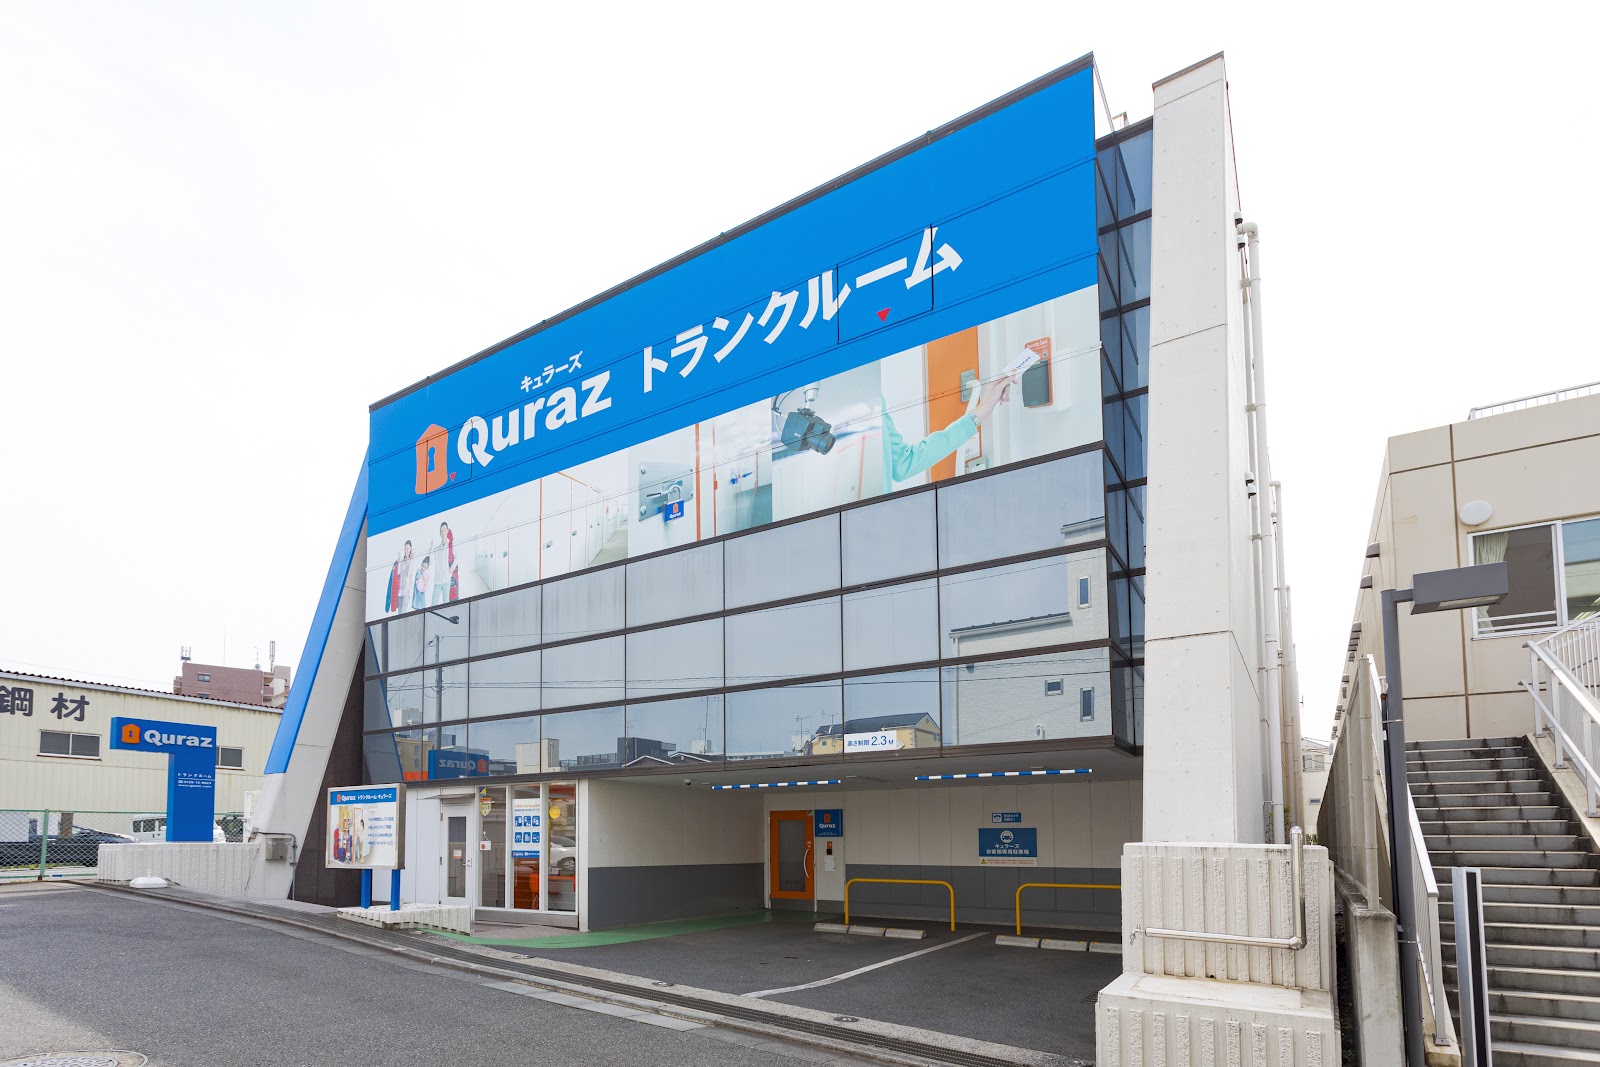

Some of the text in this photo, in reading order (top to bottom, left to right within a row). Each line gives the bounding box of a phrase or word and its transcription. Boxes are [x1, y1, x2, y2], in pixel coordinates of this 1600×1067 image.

[643, 226, 963, 393] トランクルーム
[520, 350, 583, 393] キュラーズ
[457, 370, 612, 467] Quraz
[0, 685, 90, 722] 鋼材
[143, 729, 213, 748] Quraz
[871, 735, 887, 746] 2.3
